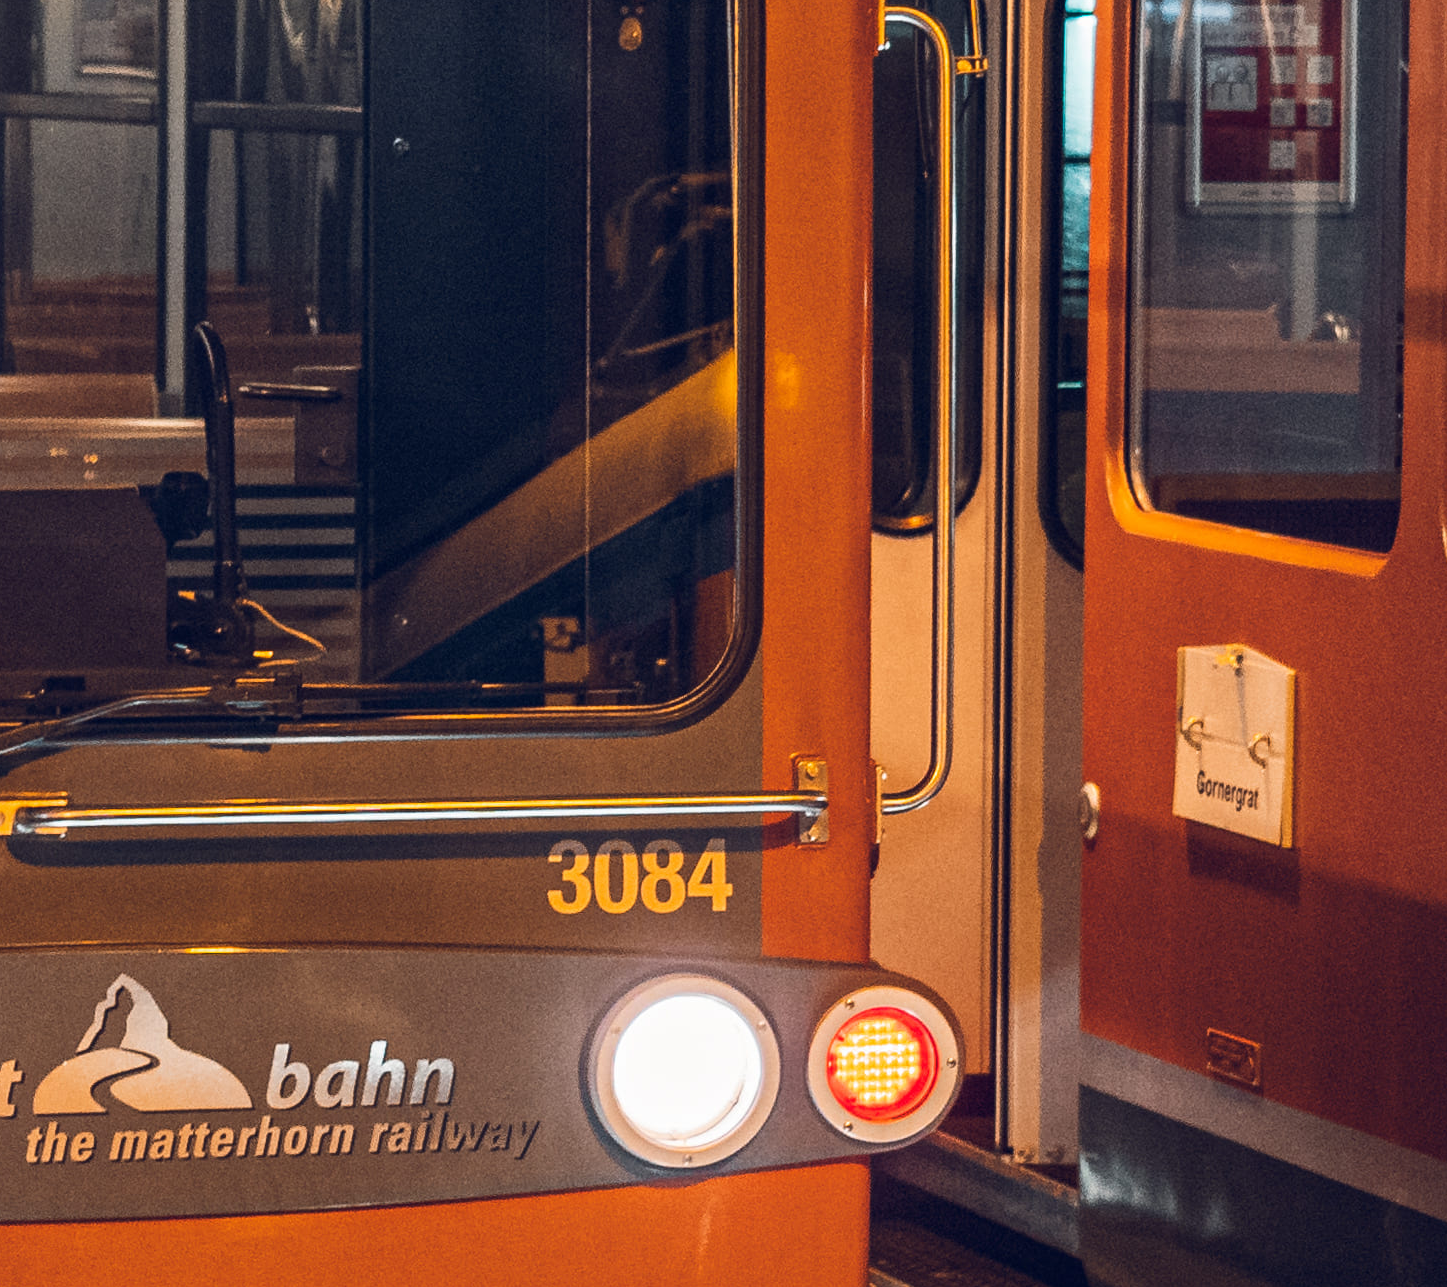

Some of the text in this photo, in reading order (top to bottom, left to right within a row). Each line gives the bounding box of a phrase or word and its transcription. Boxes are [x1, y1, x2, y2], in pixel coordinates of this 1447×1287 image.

[1196, 769, 1259, 812] Gornergrat
[547, 838, 733, 914] 3084
[266, 1040, 455, 1109] bahn
[25, 1111, 540, 1164] the matterhorn railway
